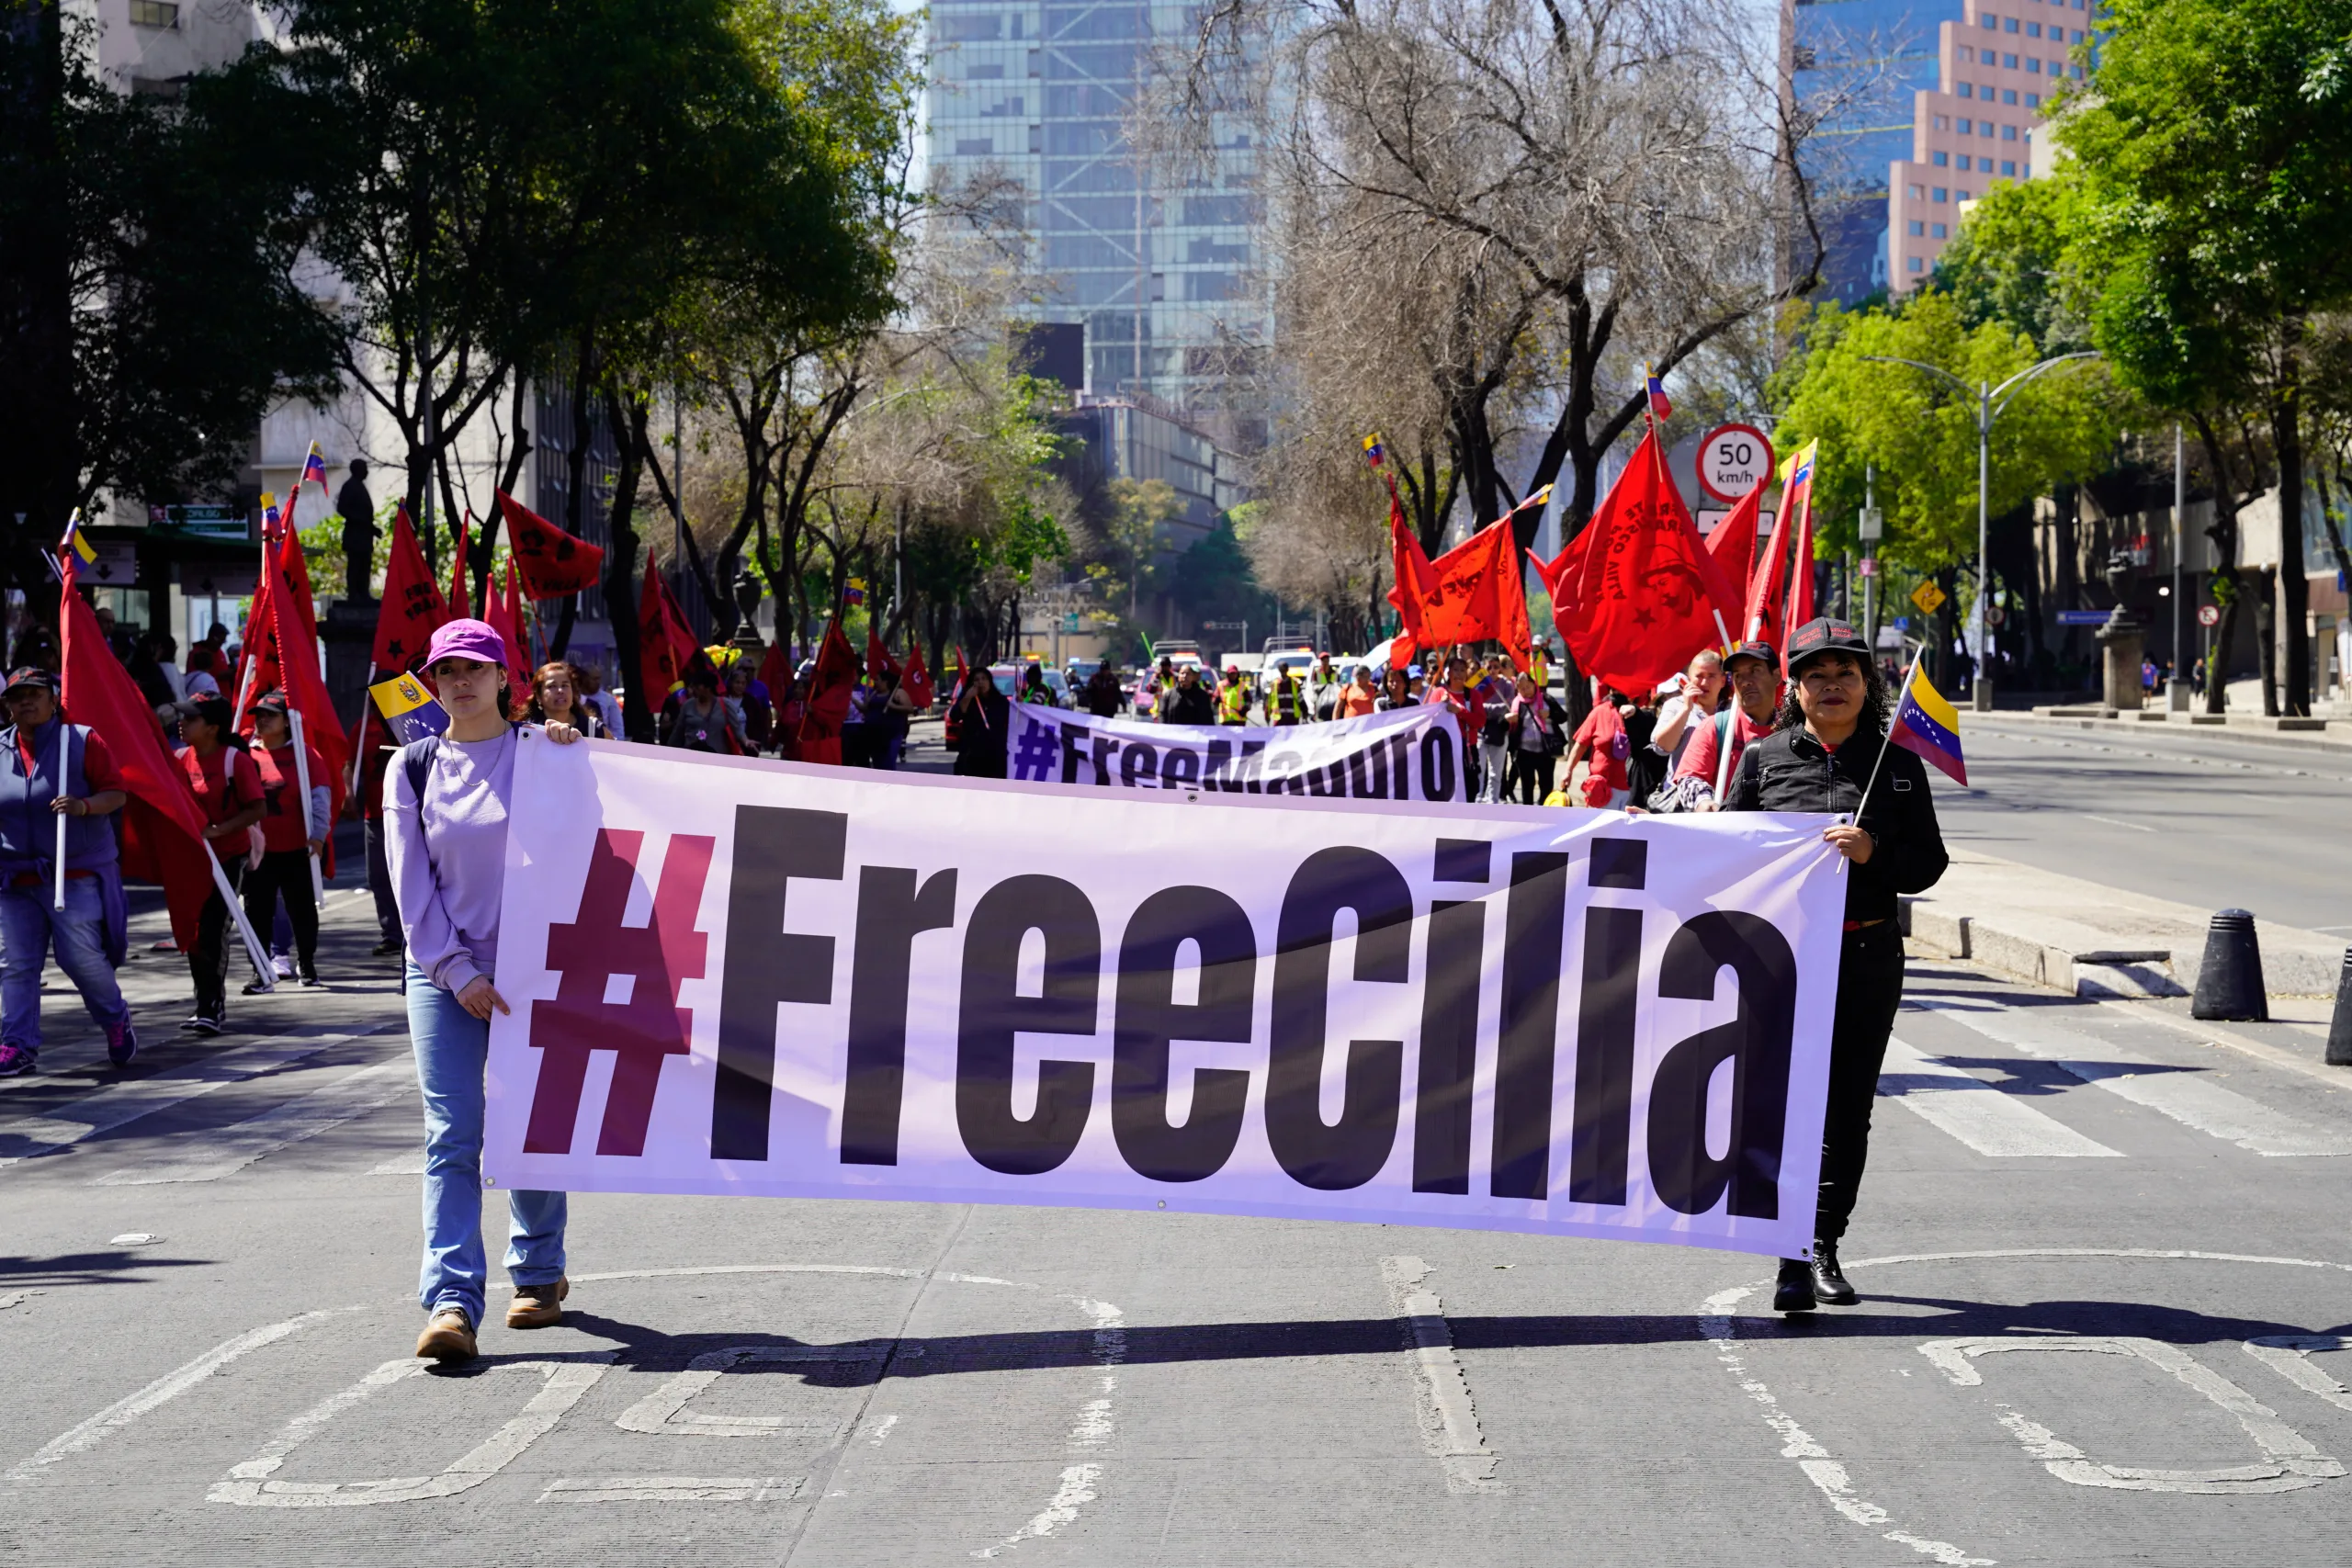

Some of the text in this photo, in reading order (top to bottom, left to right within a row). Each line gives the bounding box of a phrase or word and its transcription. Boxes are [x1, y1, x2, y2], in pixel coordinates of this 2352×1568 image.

[1717, 470, 1753, 483] km/h
[1719, 443, 1752, 466] 50
[1013, 717, 1457, 802] #FreeMaduro
[522, 803, 1801, 1220] #FreeCilia
